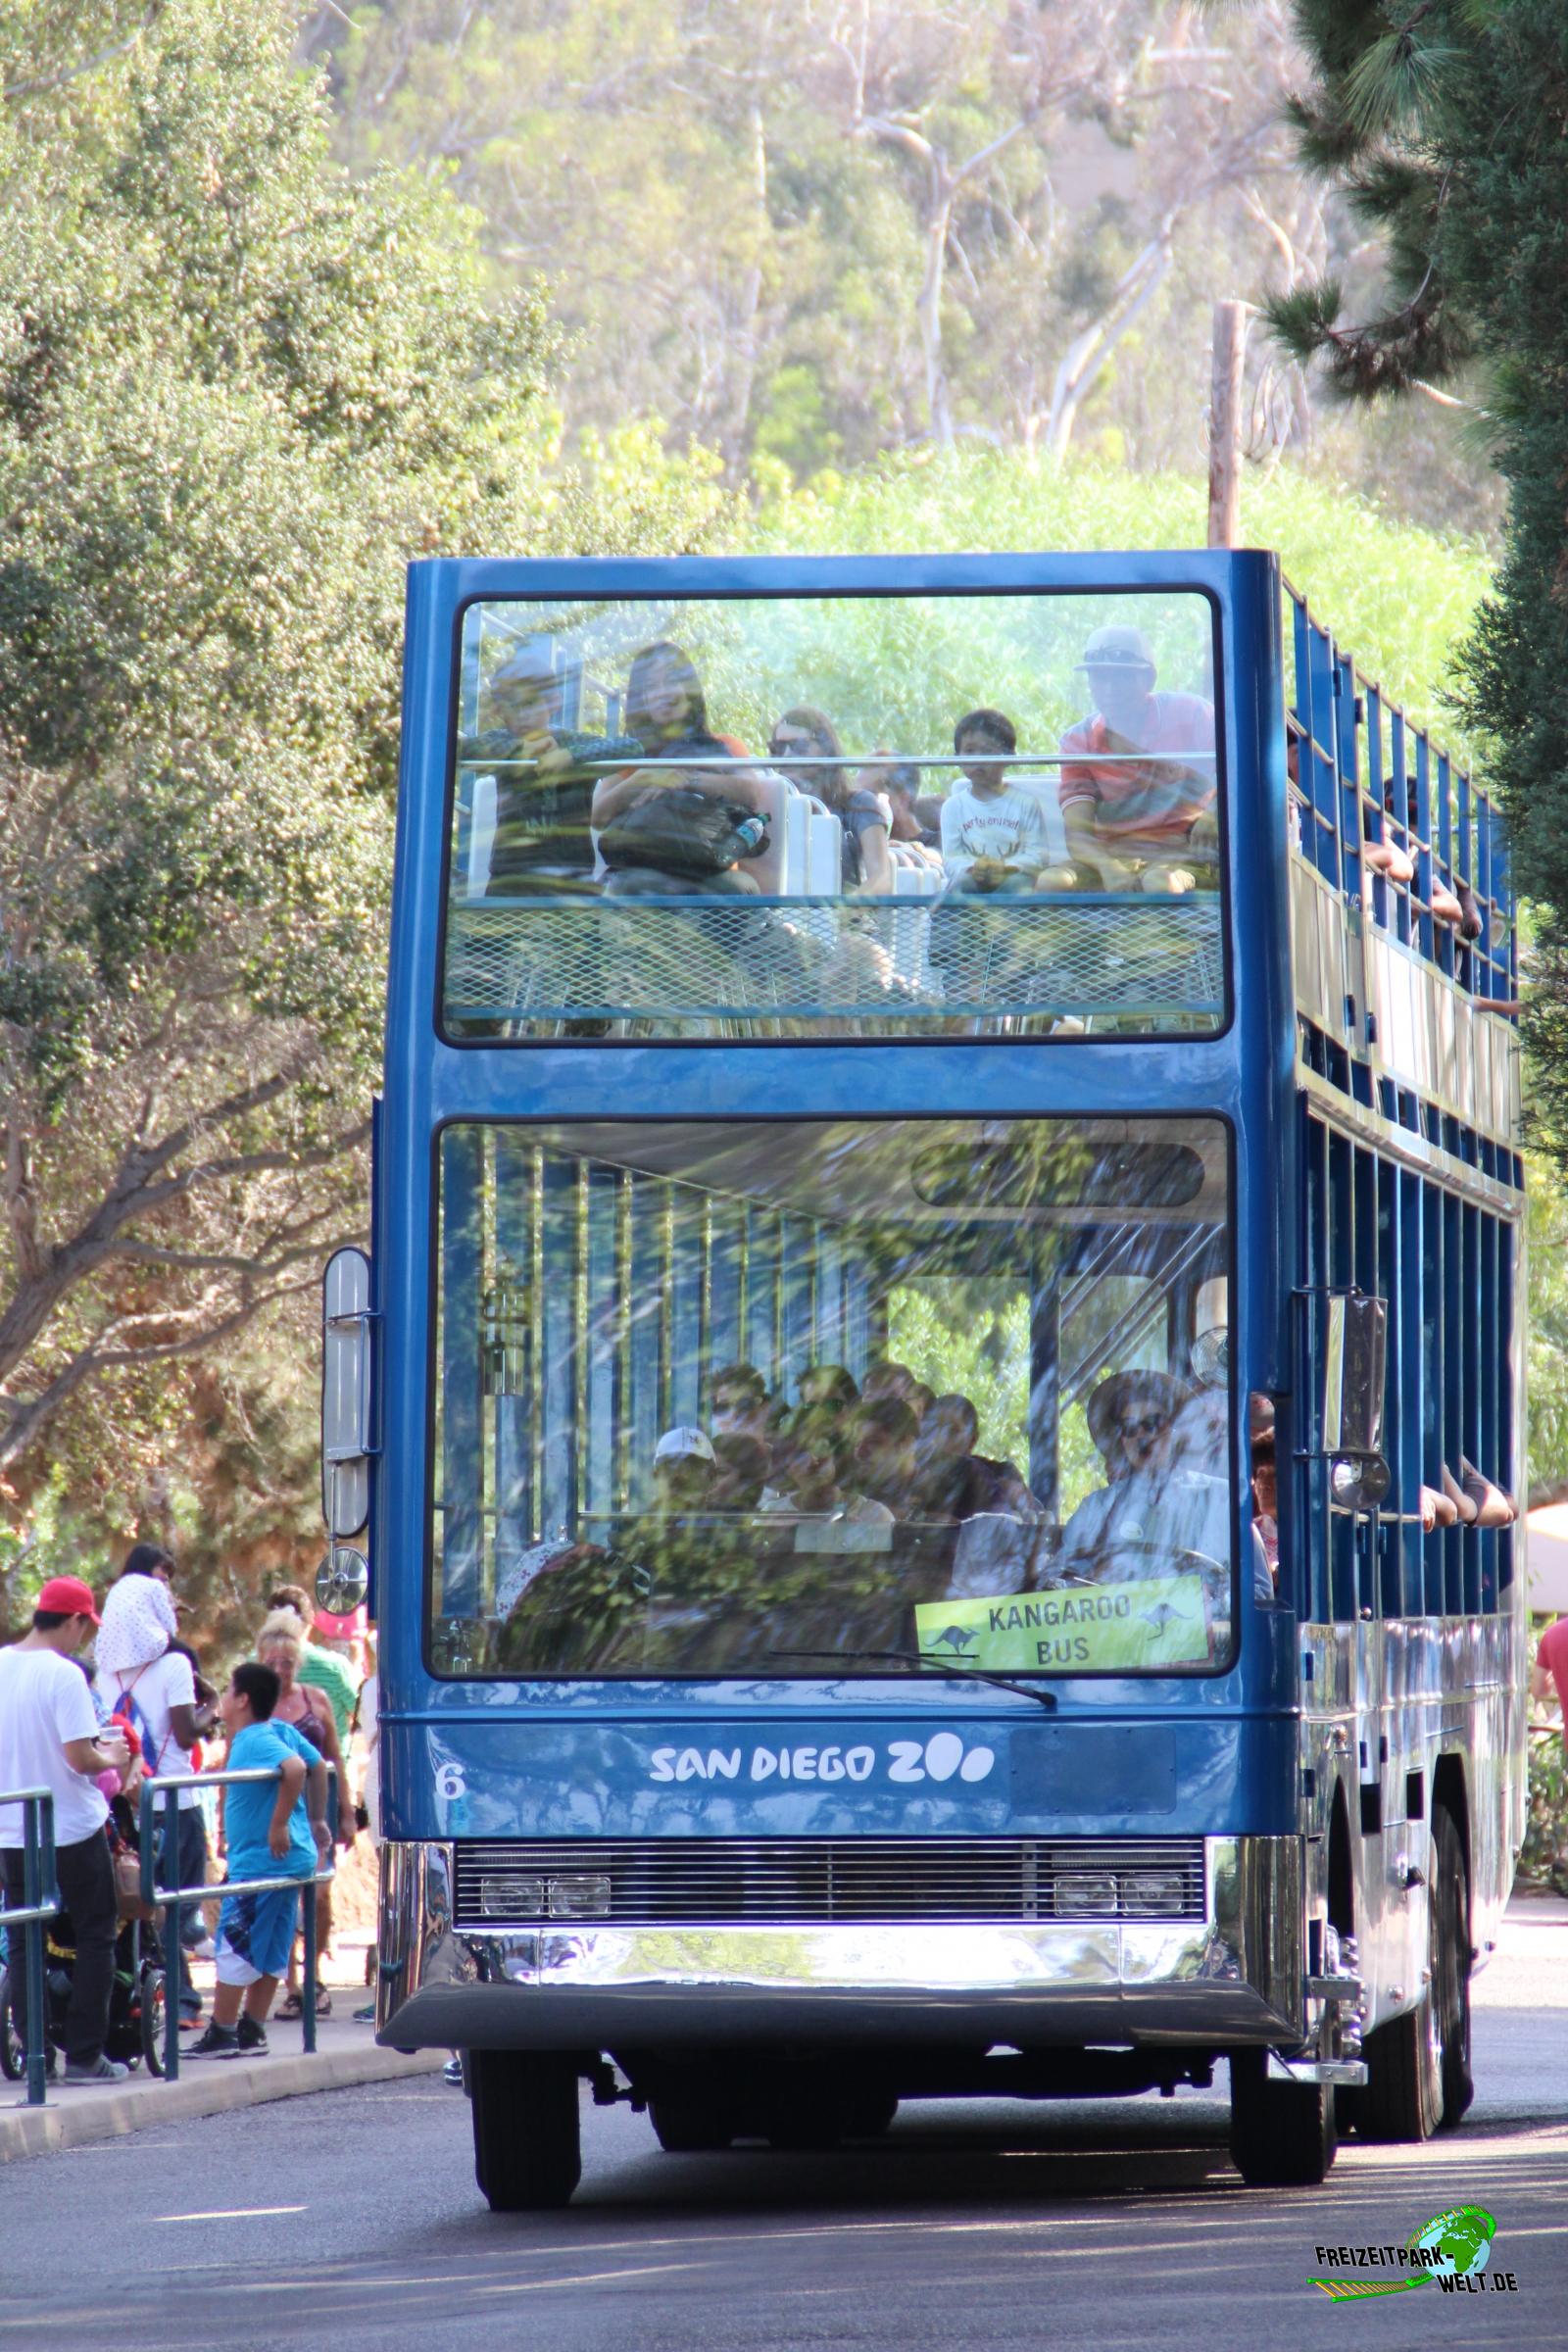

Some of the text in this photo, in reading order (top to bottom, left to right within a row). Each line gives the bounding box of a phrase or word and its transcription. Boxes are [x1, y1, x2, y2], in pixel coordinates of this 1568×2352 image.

[989, 1594, 1131, 1632] KANGAROO
[1036, 1637, 1090, 1665] BUS
[649, 1732, 995, 1783] SAN DIEGO ZOO
[435, 1763, 466, 1799] 6
